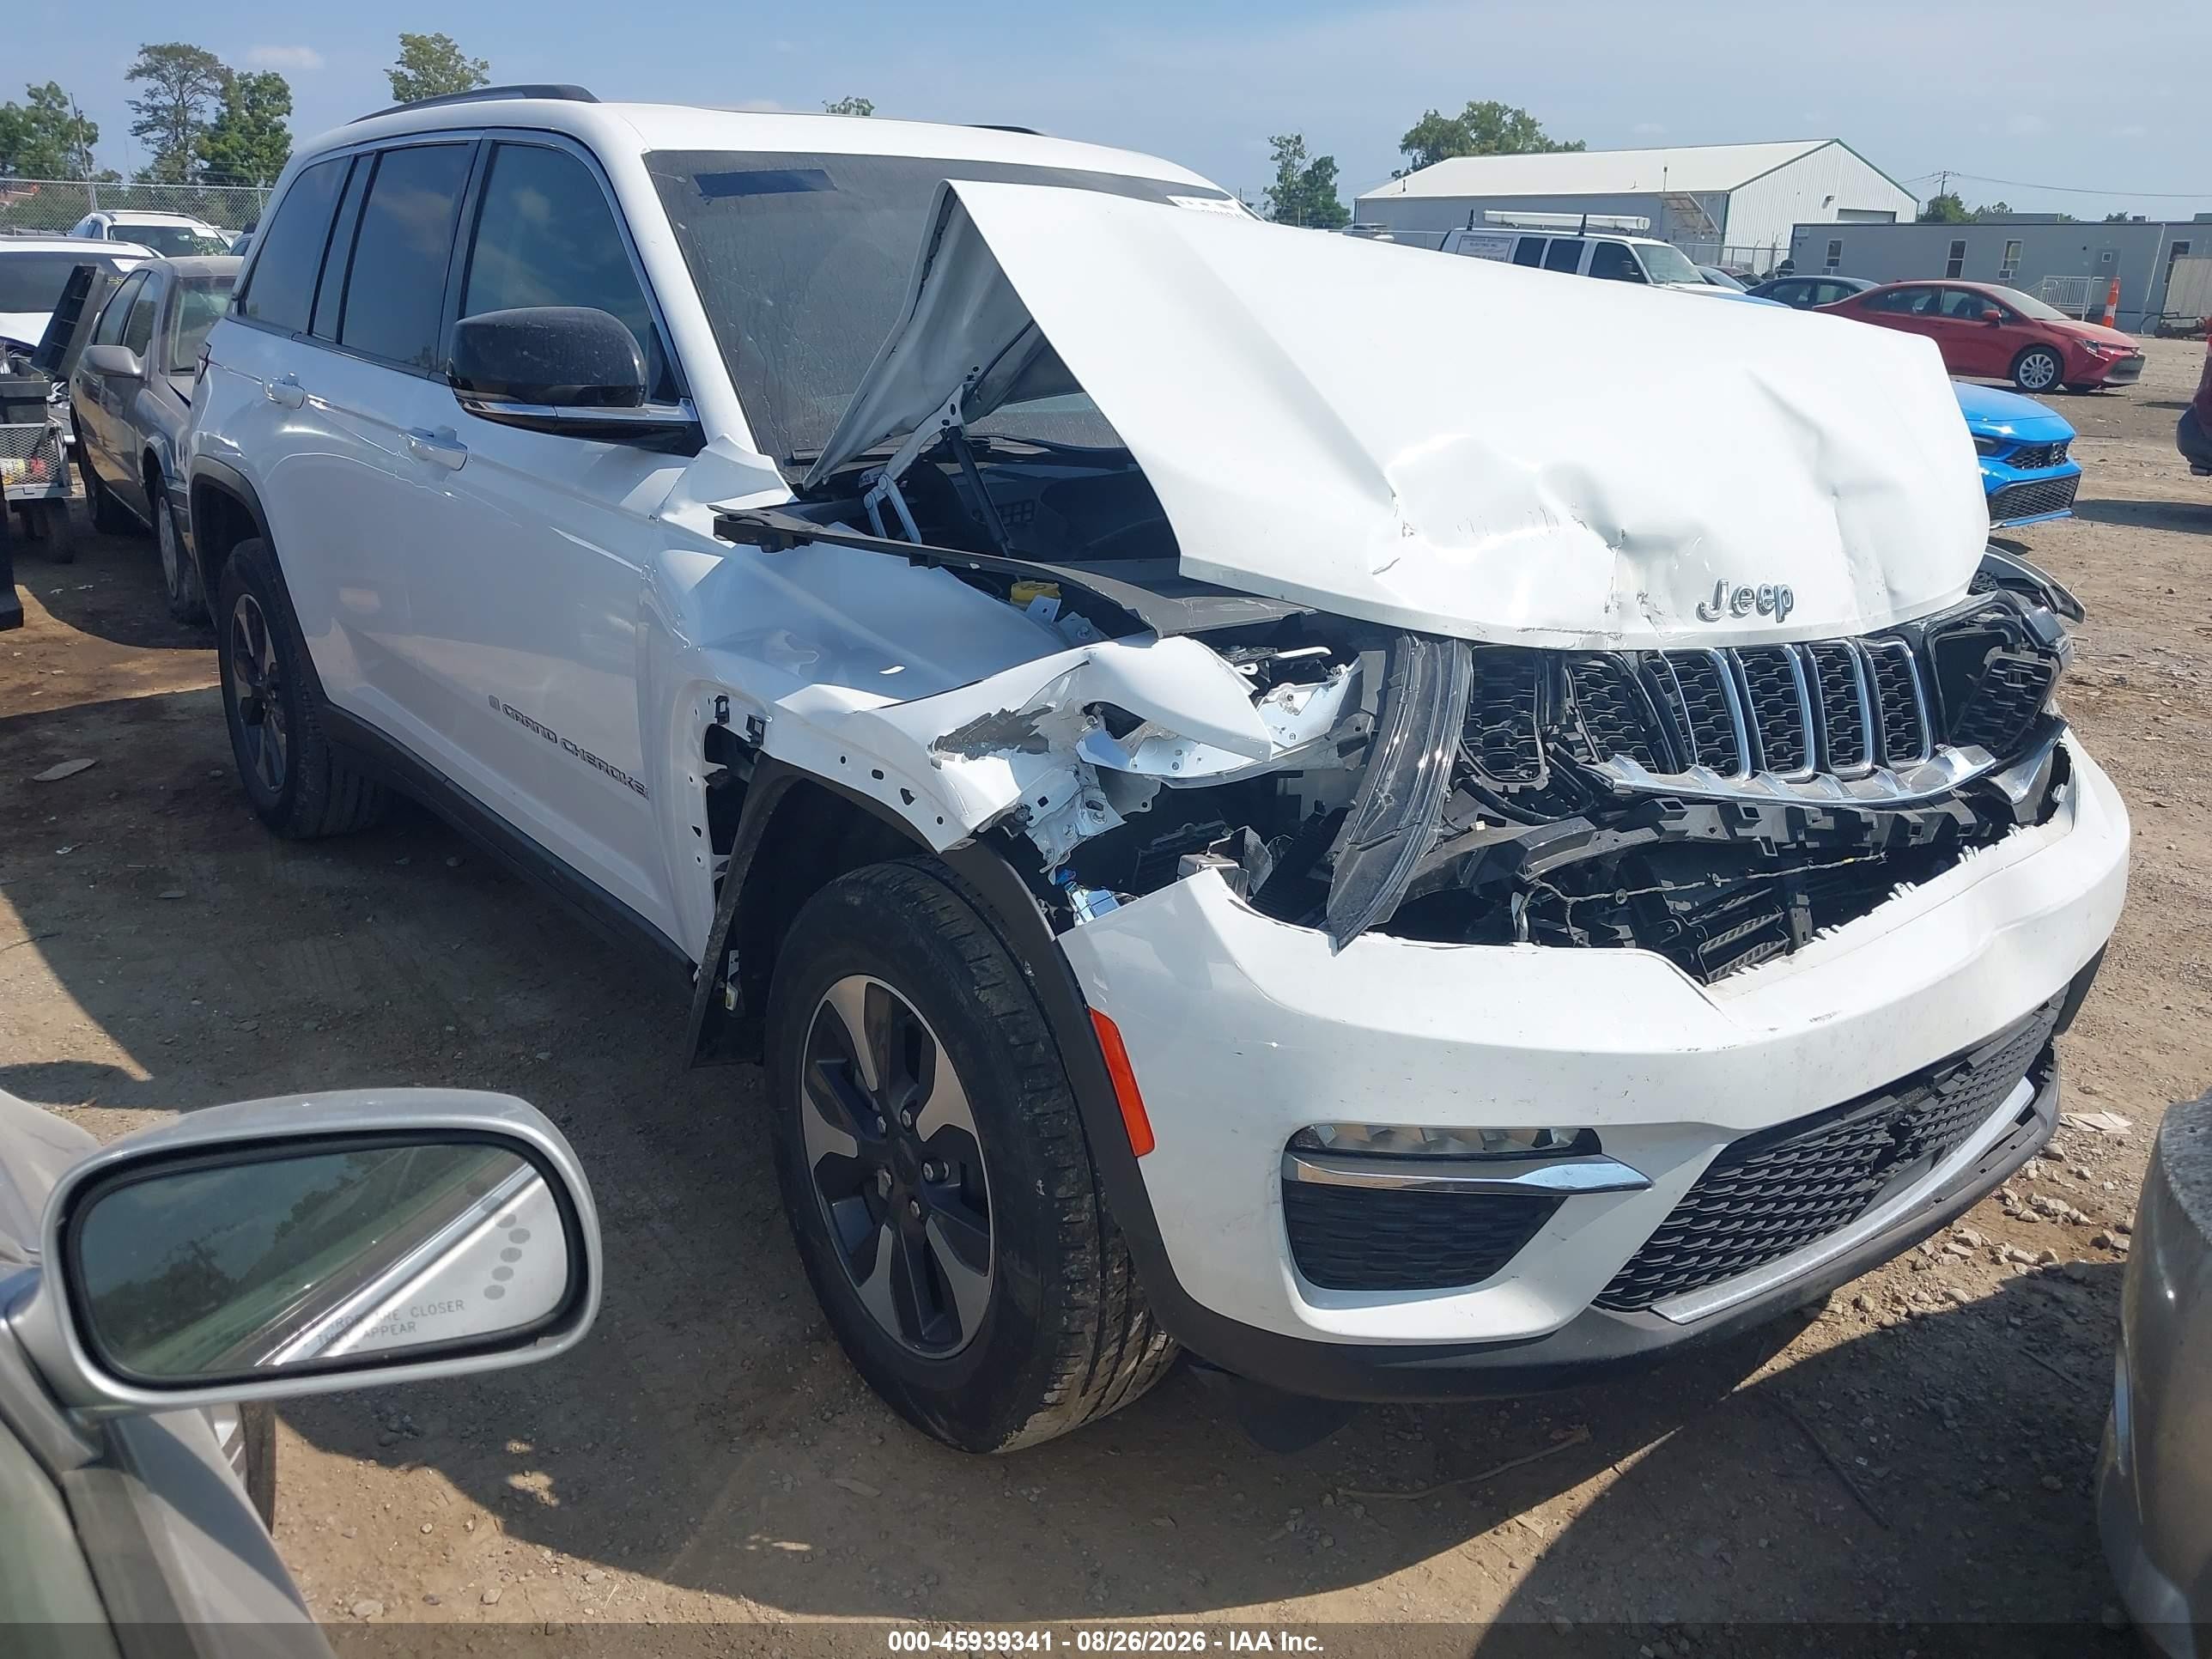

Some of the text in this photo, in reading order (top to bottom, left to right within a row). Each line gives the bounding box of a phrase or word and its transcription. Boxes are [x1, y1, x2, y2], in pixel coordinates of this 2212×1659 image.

[1696, 578, 1794, 623] Jeep
[501, 702, 650, 800] GRAND CHEROKE
[410, 1299, 465, 1319] CLOSER
[362, 1321, 417, 1341] APPEAR
